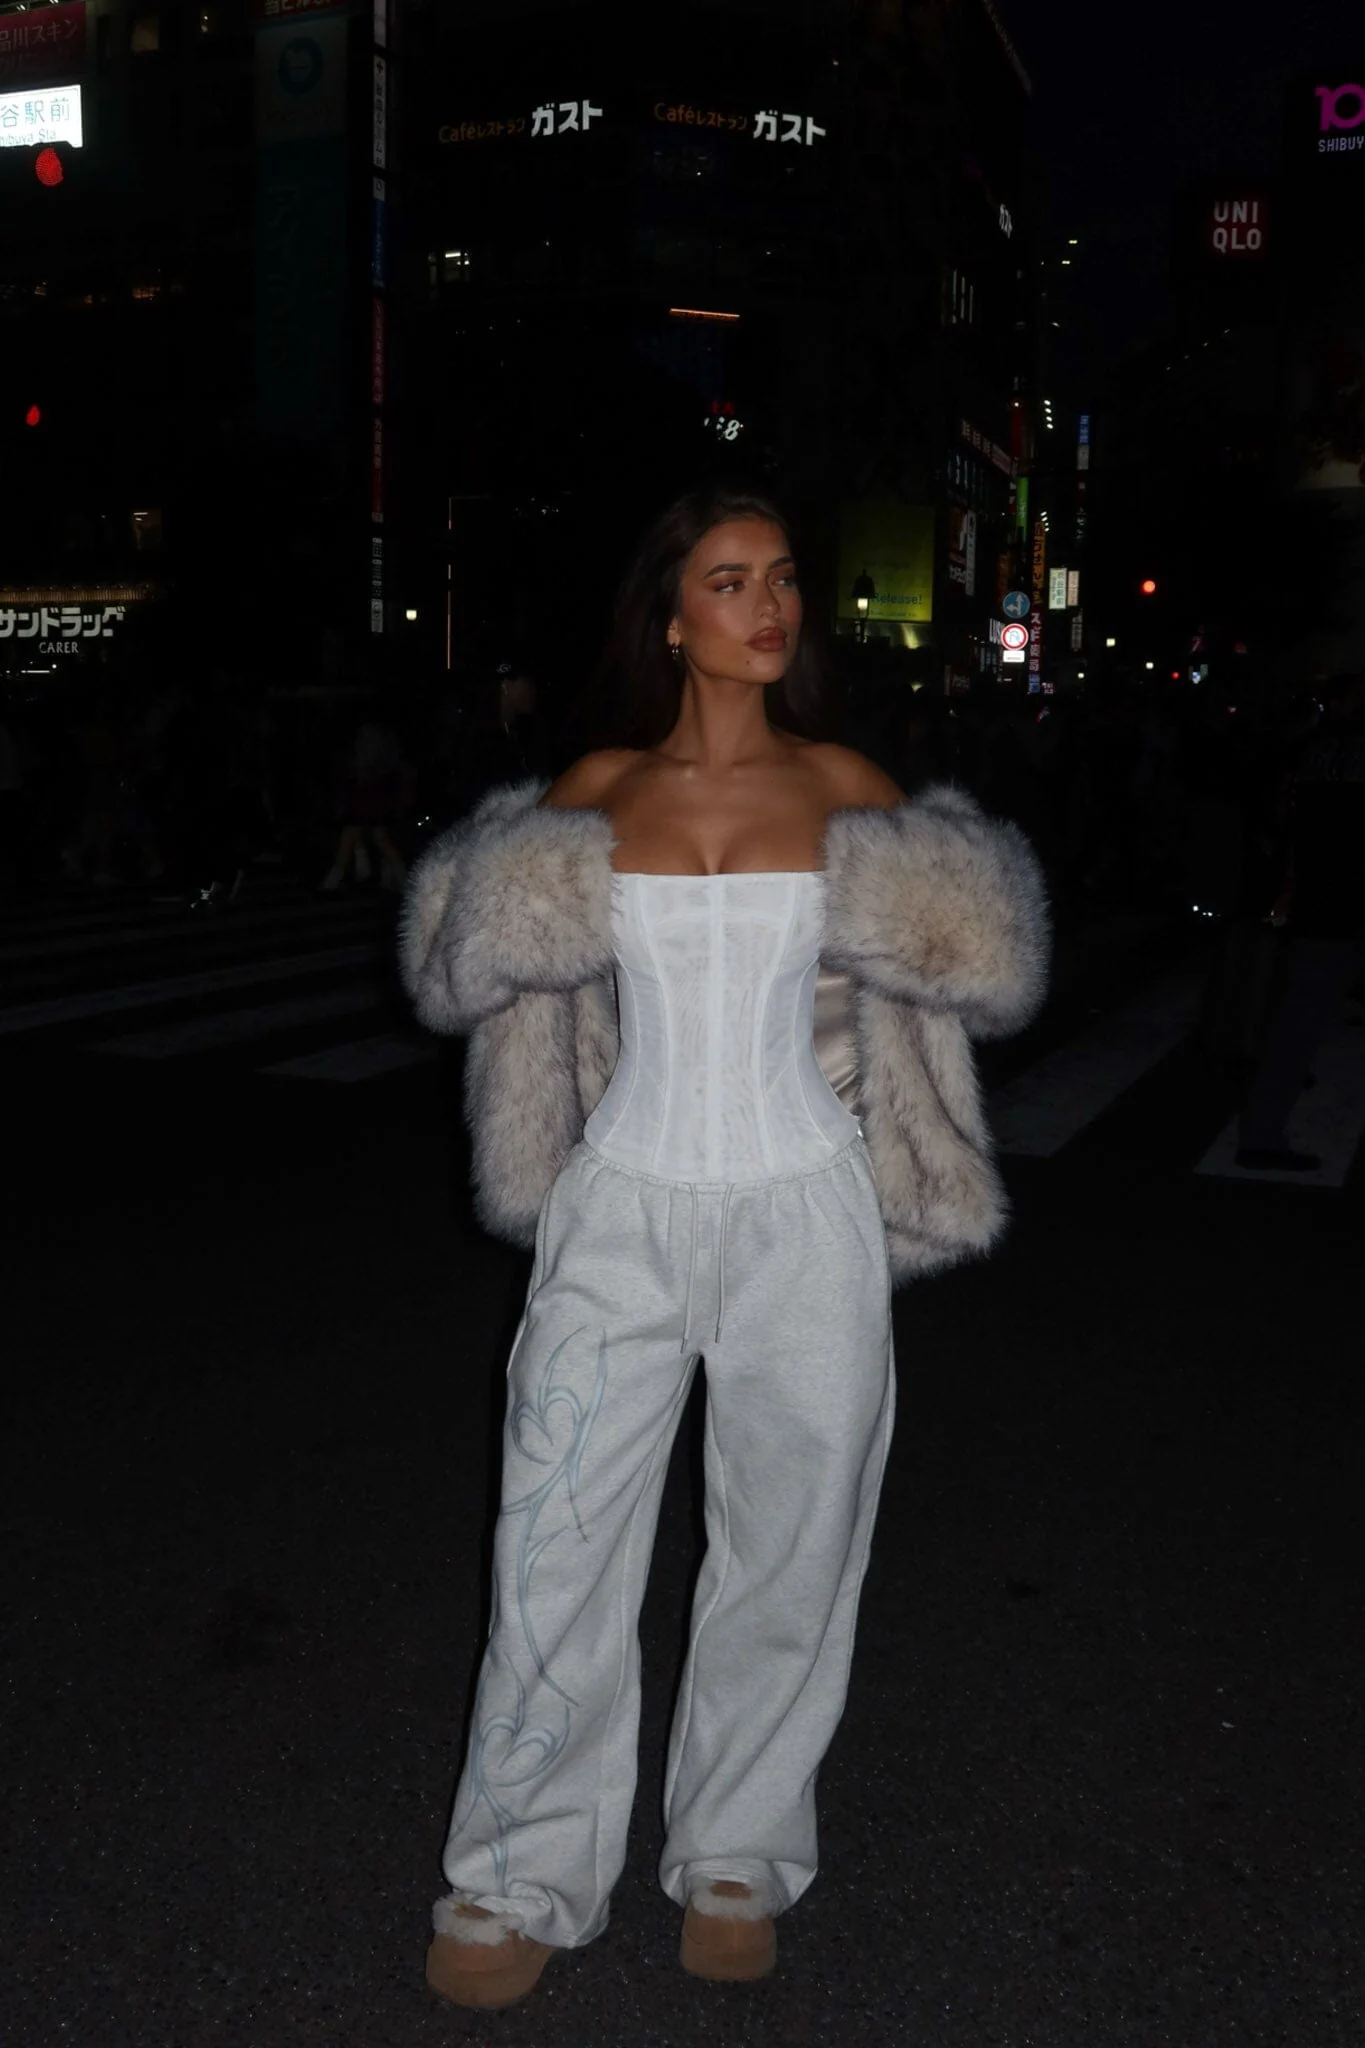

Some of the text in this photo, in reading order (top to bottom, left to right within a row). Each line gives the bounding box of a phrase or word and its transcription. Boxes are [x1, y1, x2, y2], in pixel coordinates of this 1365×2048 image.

[0, 97, 70, 128] 谷駅前
[531, 99, 604, 138] ガスト
[752, 108, 827, 146] ガスト
[1213, 200, 1259, 224] UNI
[1212, 227, 1263, 254] QLO
[0, 605, 126, 638] サンドラッグ
